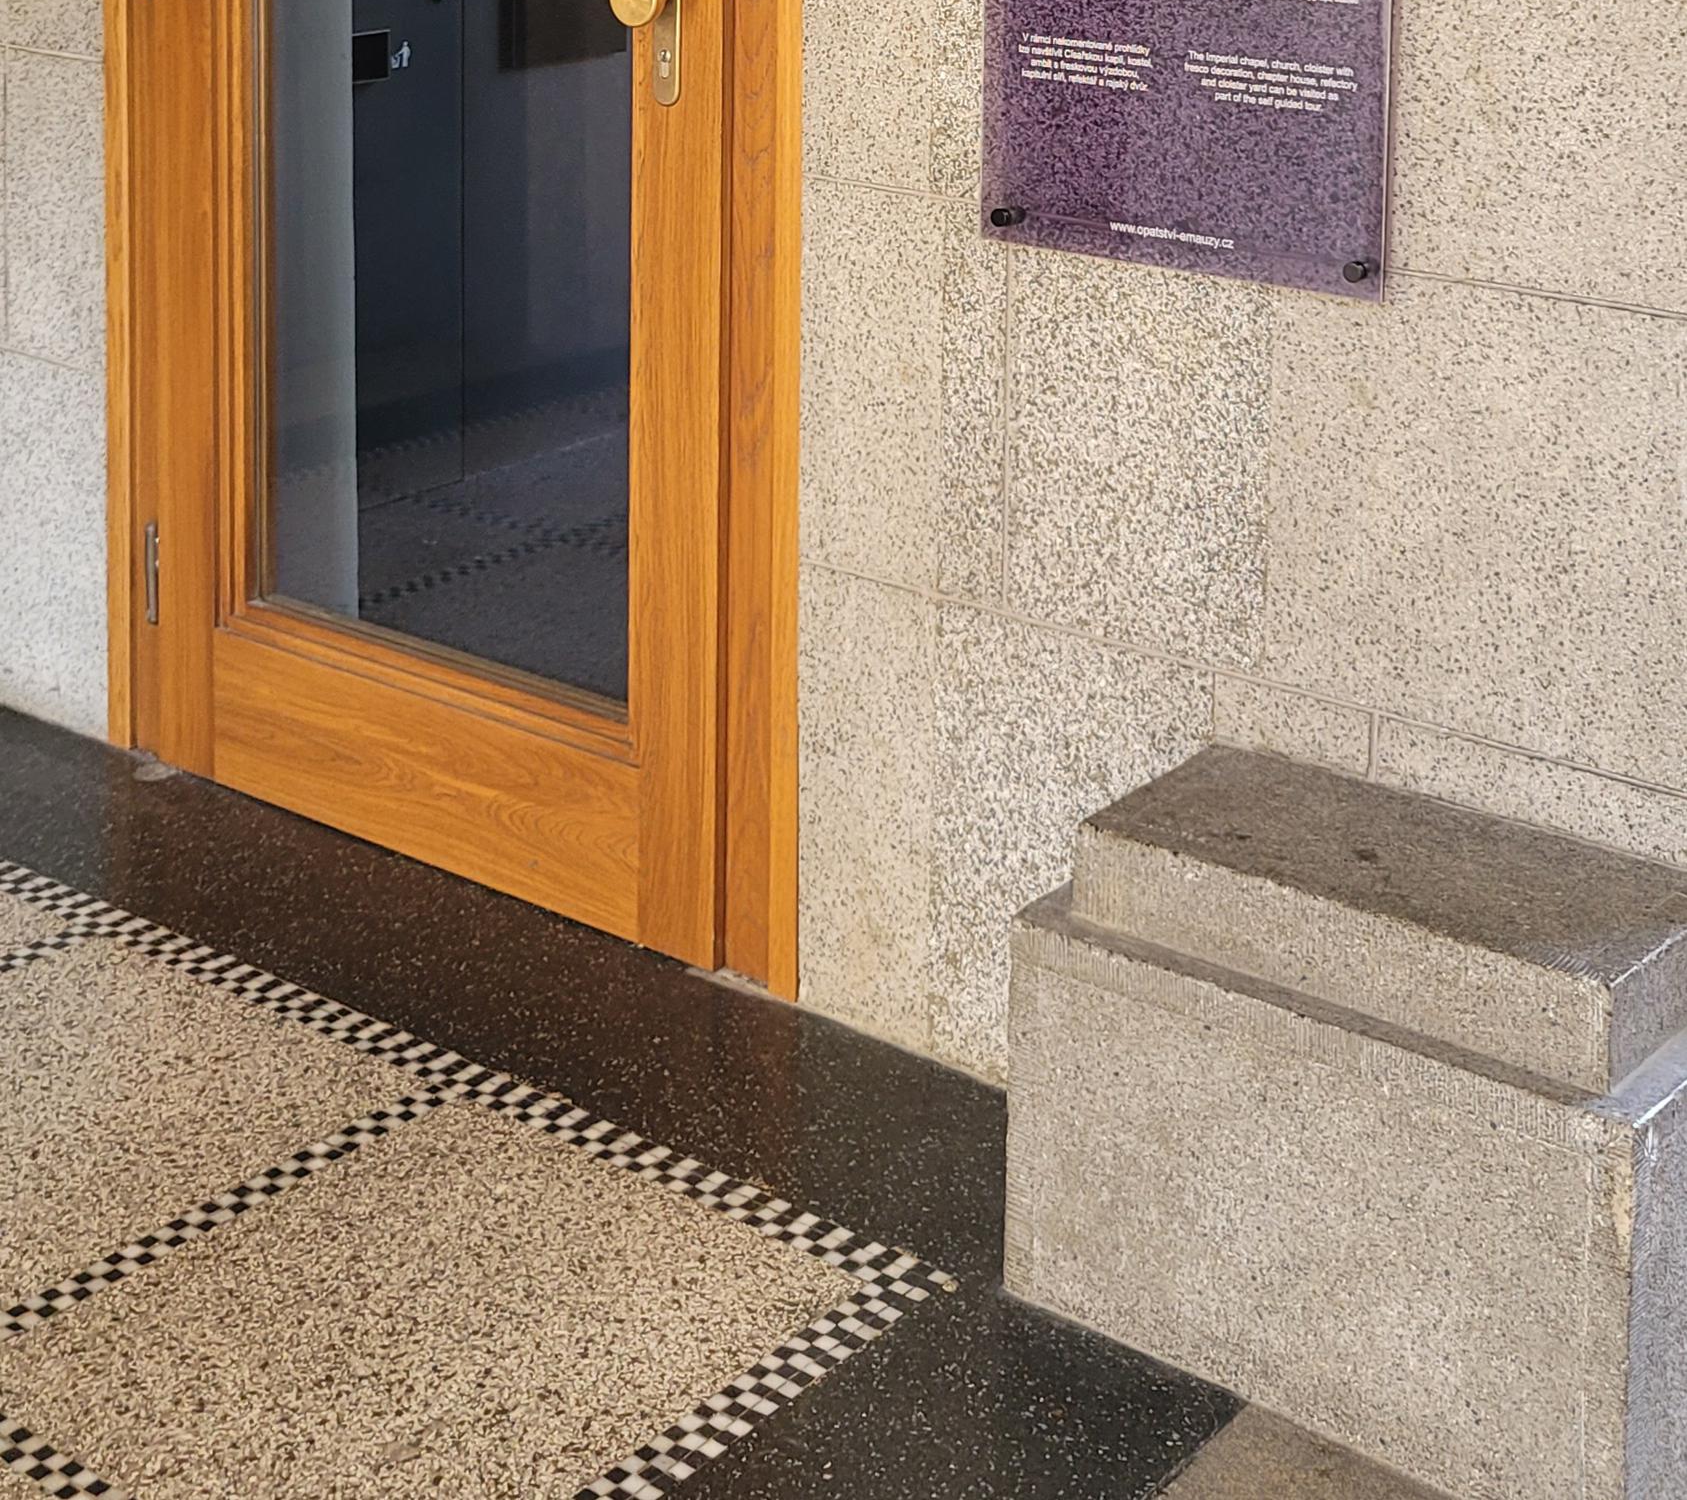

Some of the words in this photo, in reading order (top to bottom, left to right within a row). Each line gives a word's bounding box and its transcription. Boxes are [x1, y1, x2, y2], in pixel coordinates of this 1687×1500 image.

[1188, 50, 1204, 61] The
[1336, 67, 1353, 76] with
[1201, 77, 1216, 87] and
[1249, 83, 1267, 92] yard
[1269, 85, 1284, 95] can
[1286, 86, 1297, 96] be
[1215, 91, 1231, 101] part
[1243, 94, 1256, 105] the
[1275, 99, 1303, 109] guided
[1110, 221, 1234, 249] www.opatstvi-emauzy.cz
